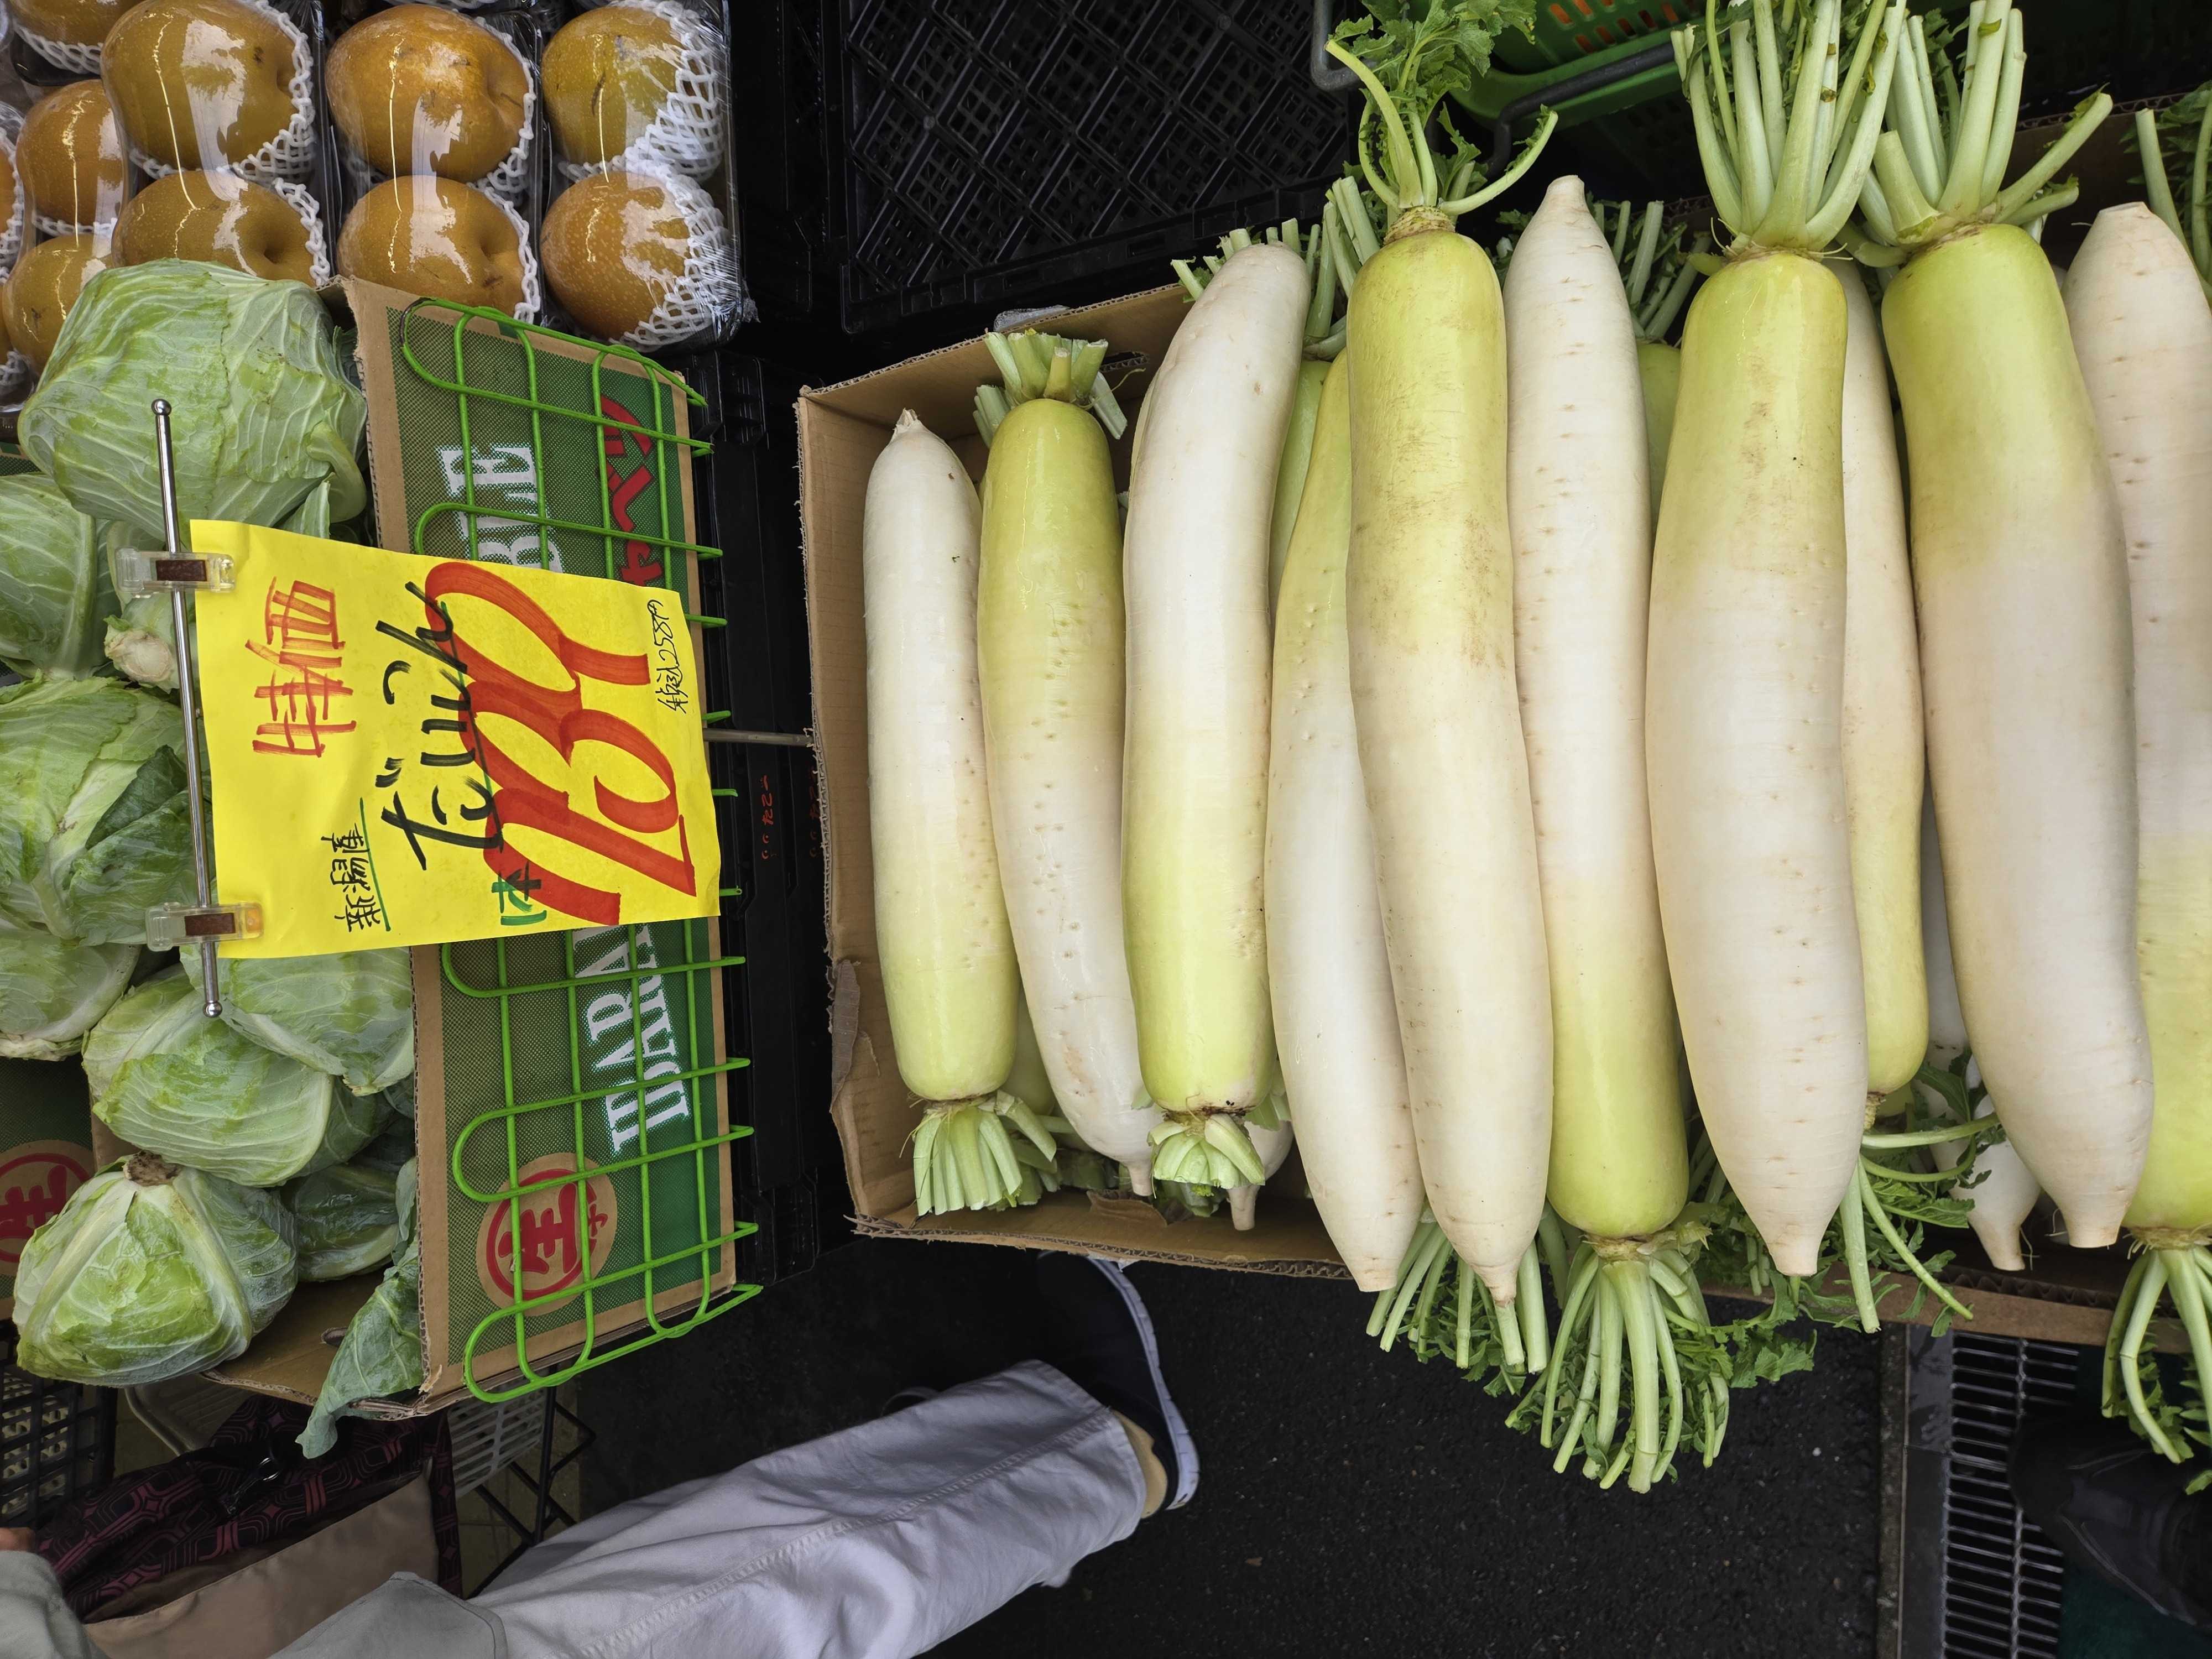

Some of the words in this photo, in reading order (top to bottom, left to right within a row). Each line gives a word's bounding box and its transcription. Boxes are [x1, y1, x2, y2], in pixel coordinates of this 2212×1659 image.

[438, 446, 564, 573] BLE
[601, 393, 662, 587] ャベツ
[244, 577, 356, 758] 特価
[375, 581, 500, 870] だいこん
[425, 562, 696, 926] 239
[646, 599, 688, 714] 税込258円
[321, 823, 380, 932] 新潟産
